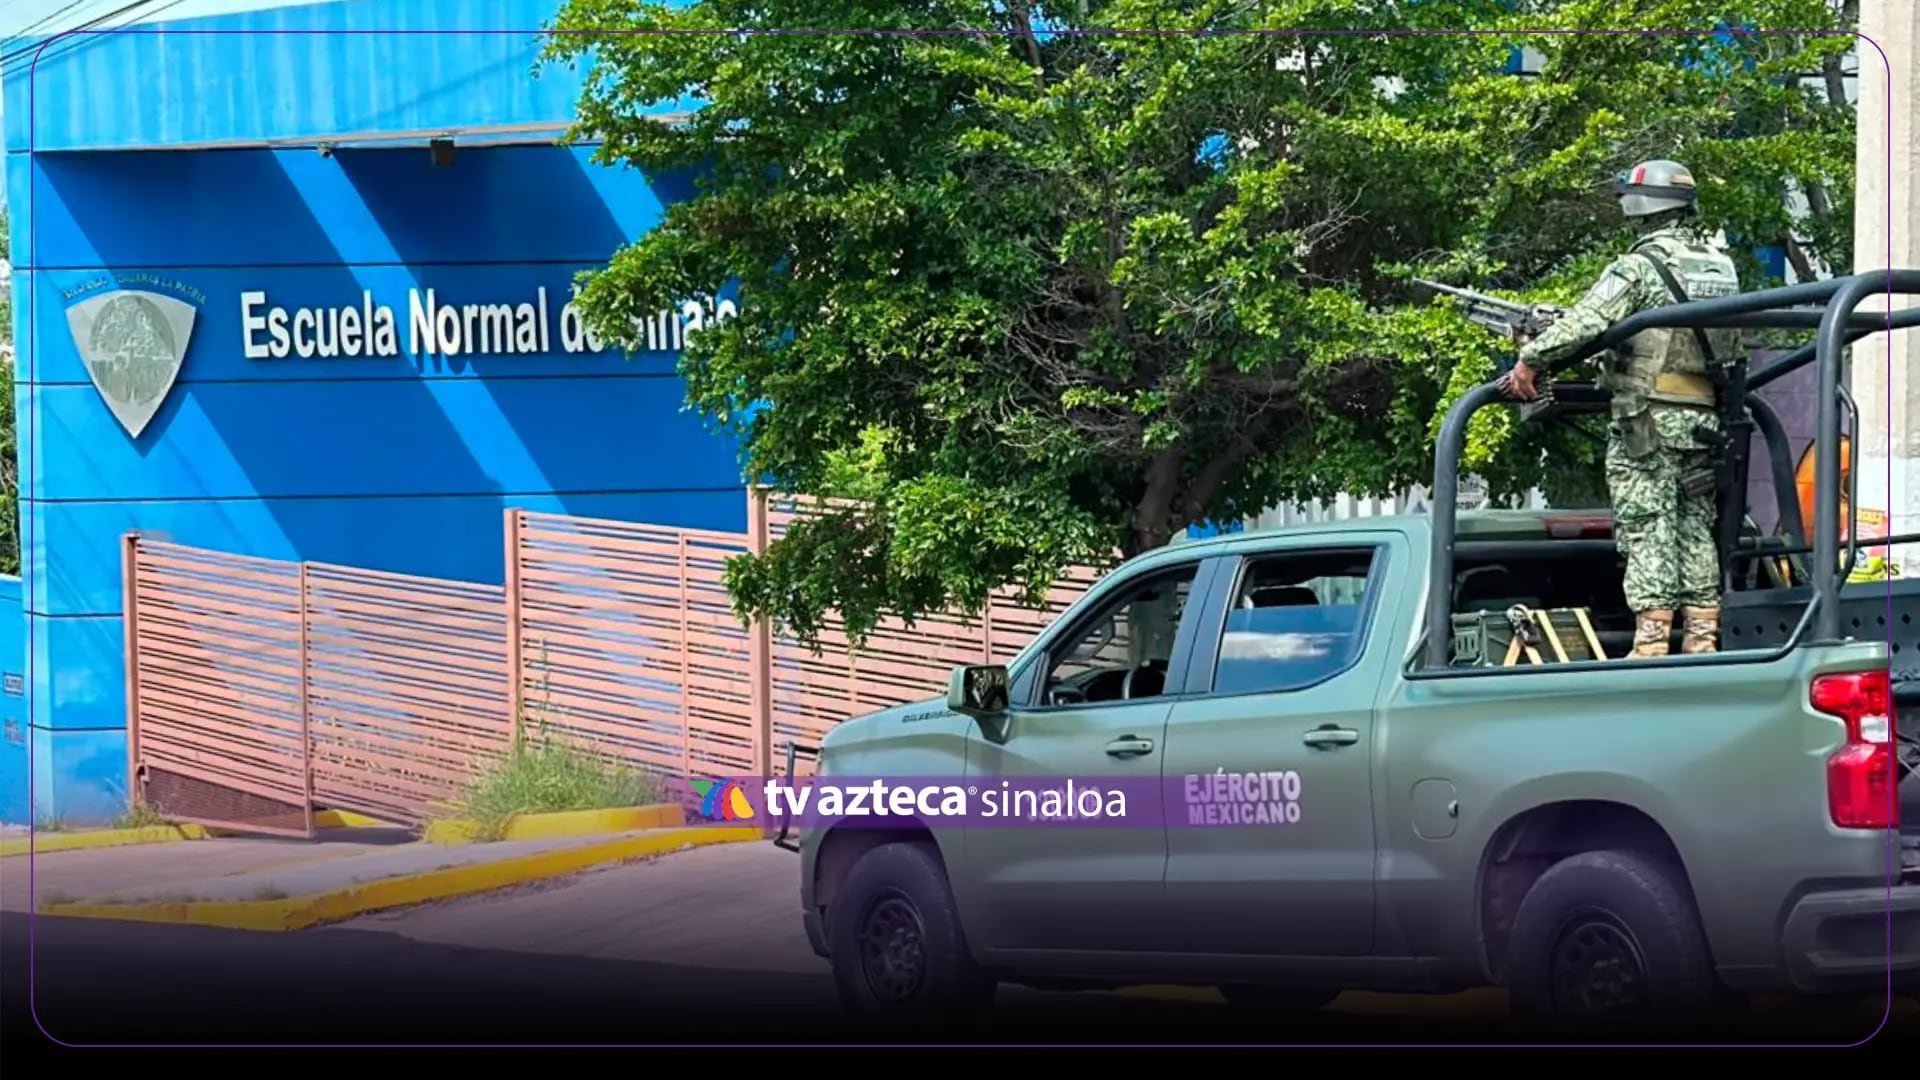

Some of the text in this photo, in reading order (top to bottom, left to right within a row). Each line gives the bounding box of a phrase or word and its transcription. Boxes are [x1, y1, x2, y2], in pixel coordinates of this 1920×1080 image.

[174, 282, 207, 305] PATRIA
[240, 287, 398, 358] Escuela
[410, 286, 550, 355] Normal
[1185, 766, 1301, 803] EJÉRCITO
[1188, 801, 1301, 825] MEXICANO
